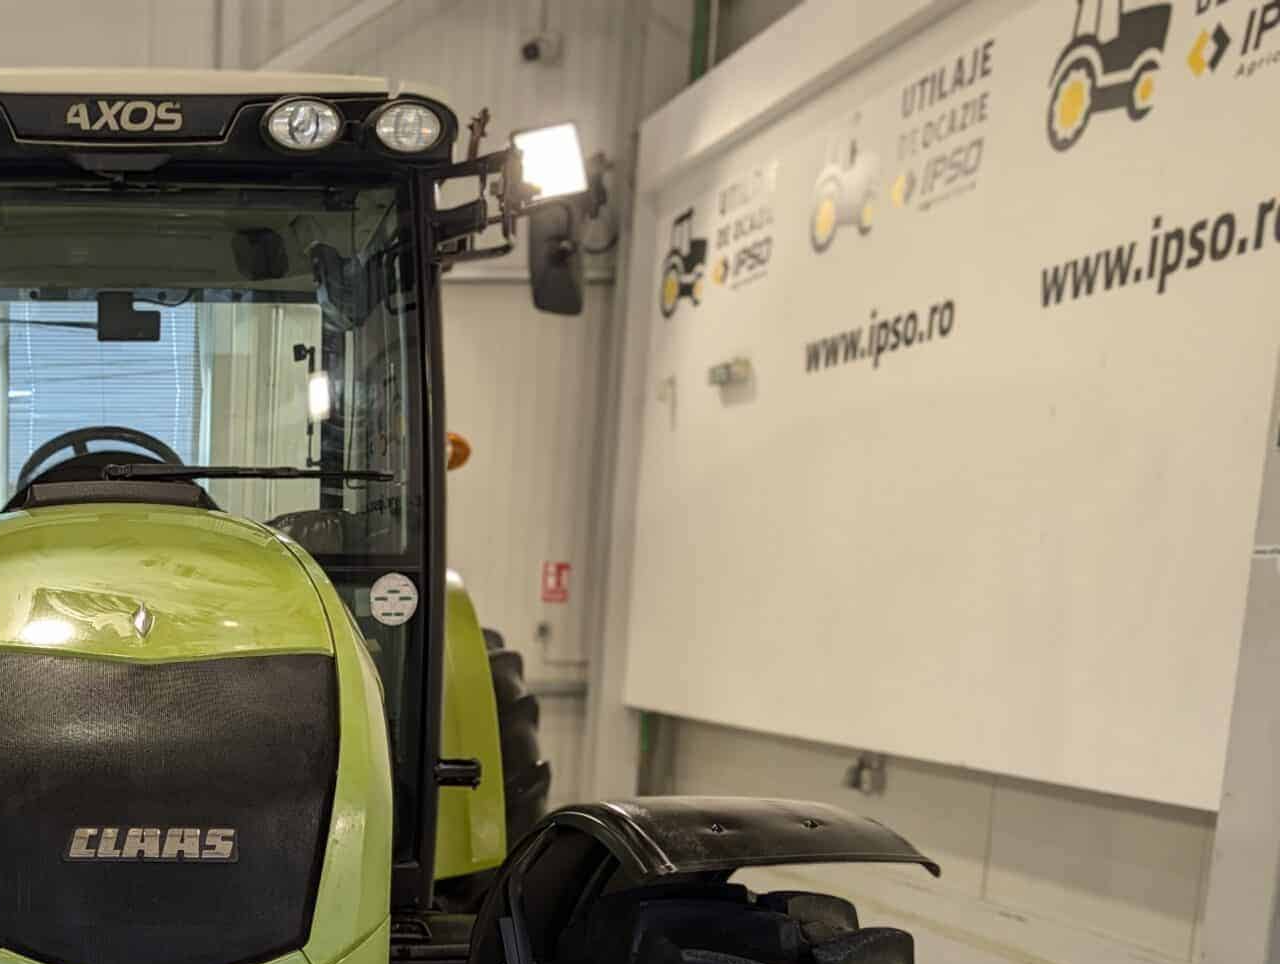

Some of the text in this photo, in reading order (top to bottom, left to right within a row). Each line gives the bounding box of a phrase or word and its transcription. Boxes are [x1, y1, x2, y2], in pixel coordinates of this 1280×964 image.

[901, 39, 995, 118] UTILAJE
[67, 101, 183, 132] AXOS
[920, 138, 984, 195] IPSO
[1041, 197, 1280, 308] www.ipso.r
[805, 299, 956, 373] www.ipso.ro
[70, 828, 235, 858] CLAAS
